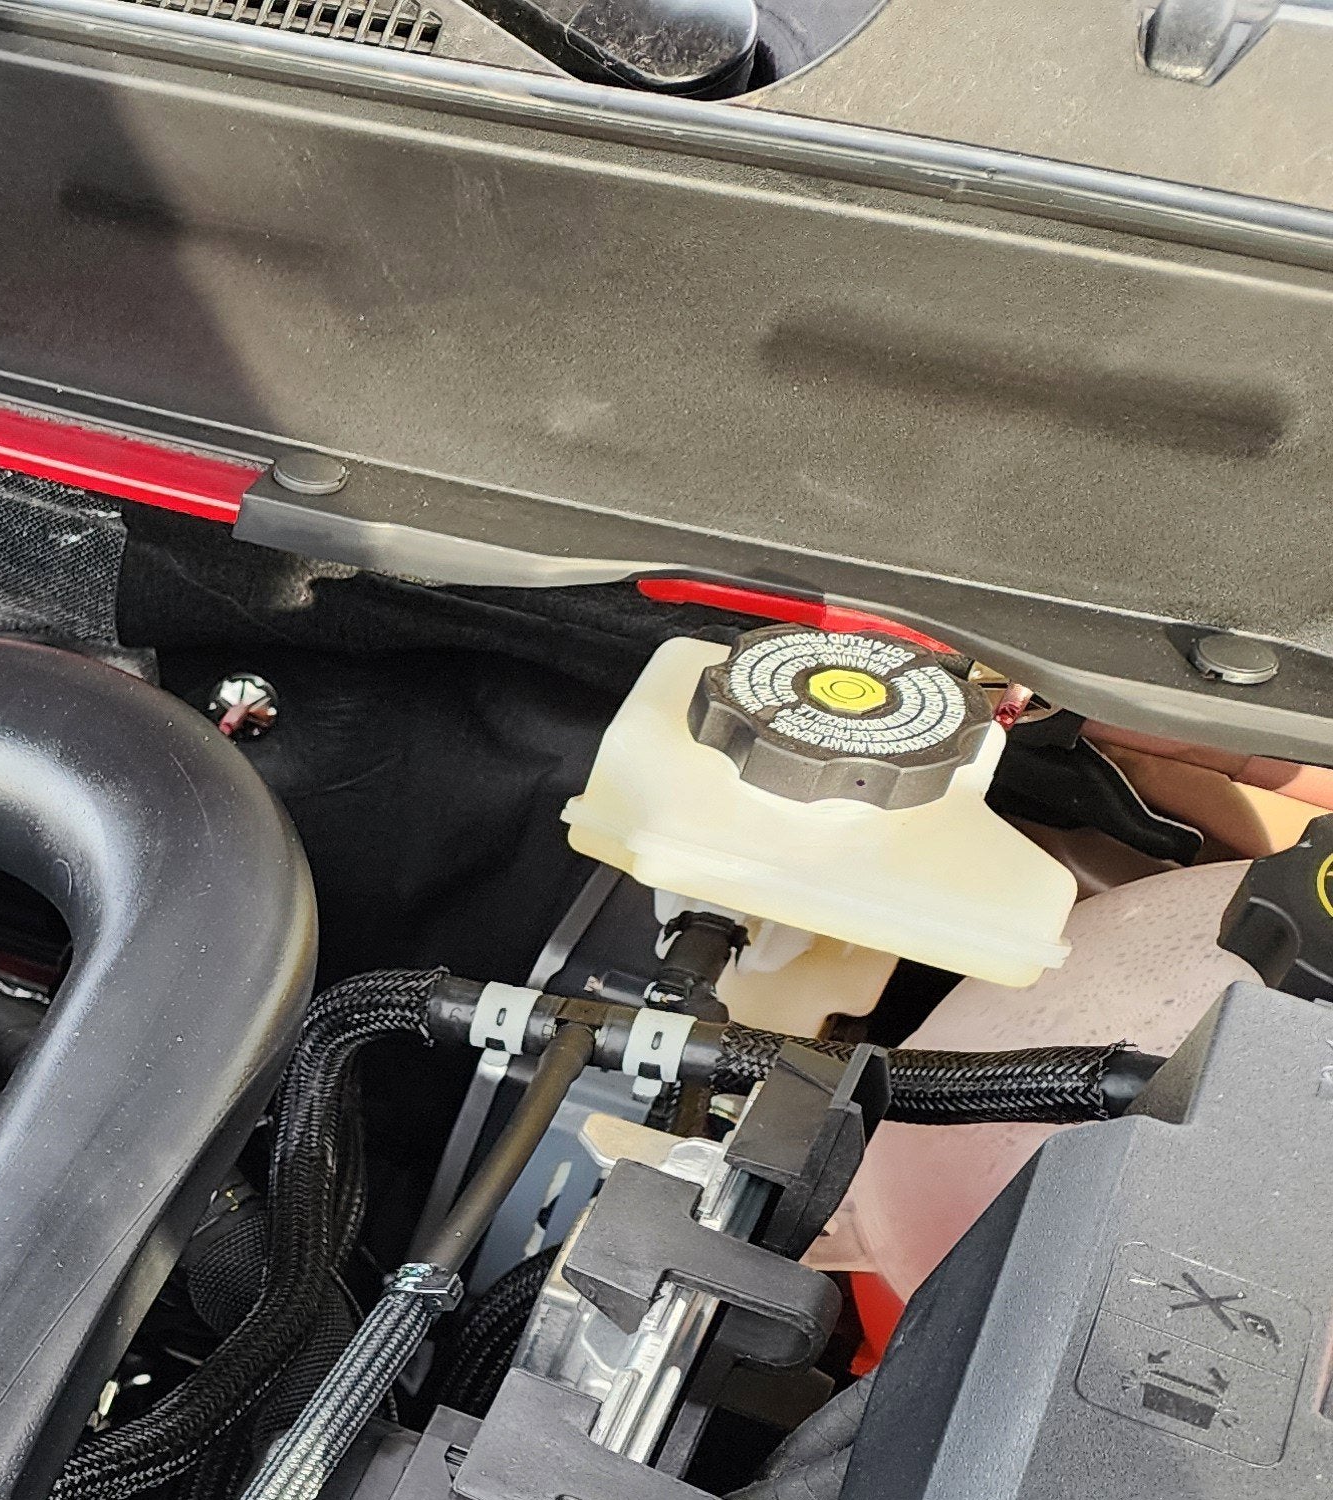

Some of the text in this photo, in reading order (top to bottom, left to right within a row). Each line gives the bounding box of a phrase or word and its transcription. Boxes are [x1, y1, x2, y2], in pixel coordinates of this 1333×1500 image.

[782, 633, 832, 646] FROM
[830, 633, 875, 647] FLUID
[811, 643, 875, 658] BEFORE
[870, 649, 908, 668] CAP
[814, 653, 895, 676] WARNING:
[805, 723, 849, 741] FREIN
[819, 738, 868, 755] AVANT
